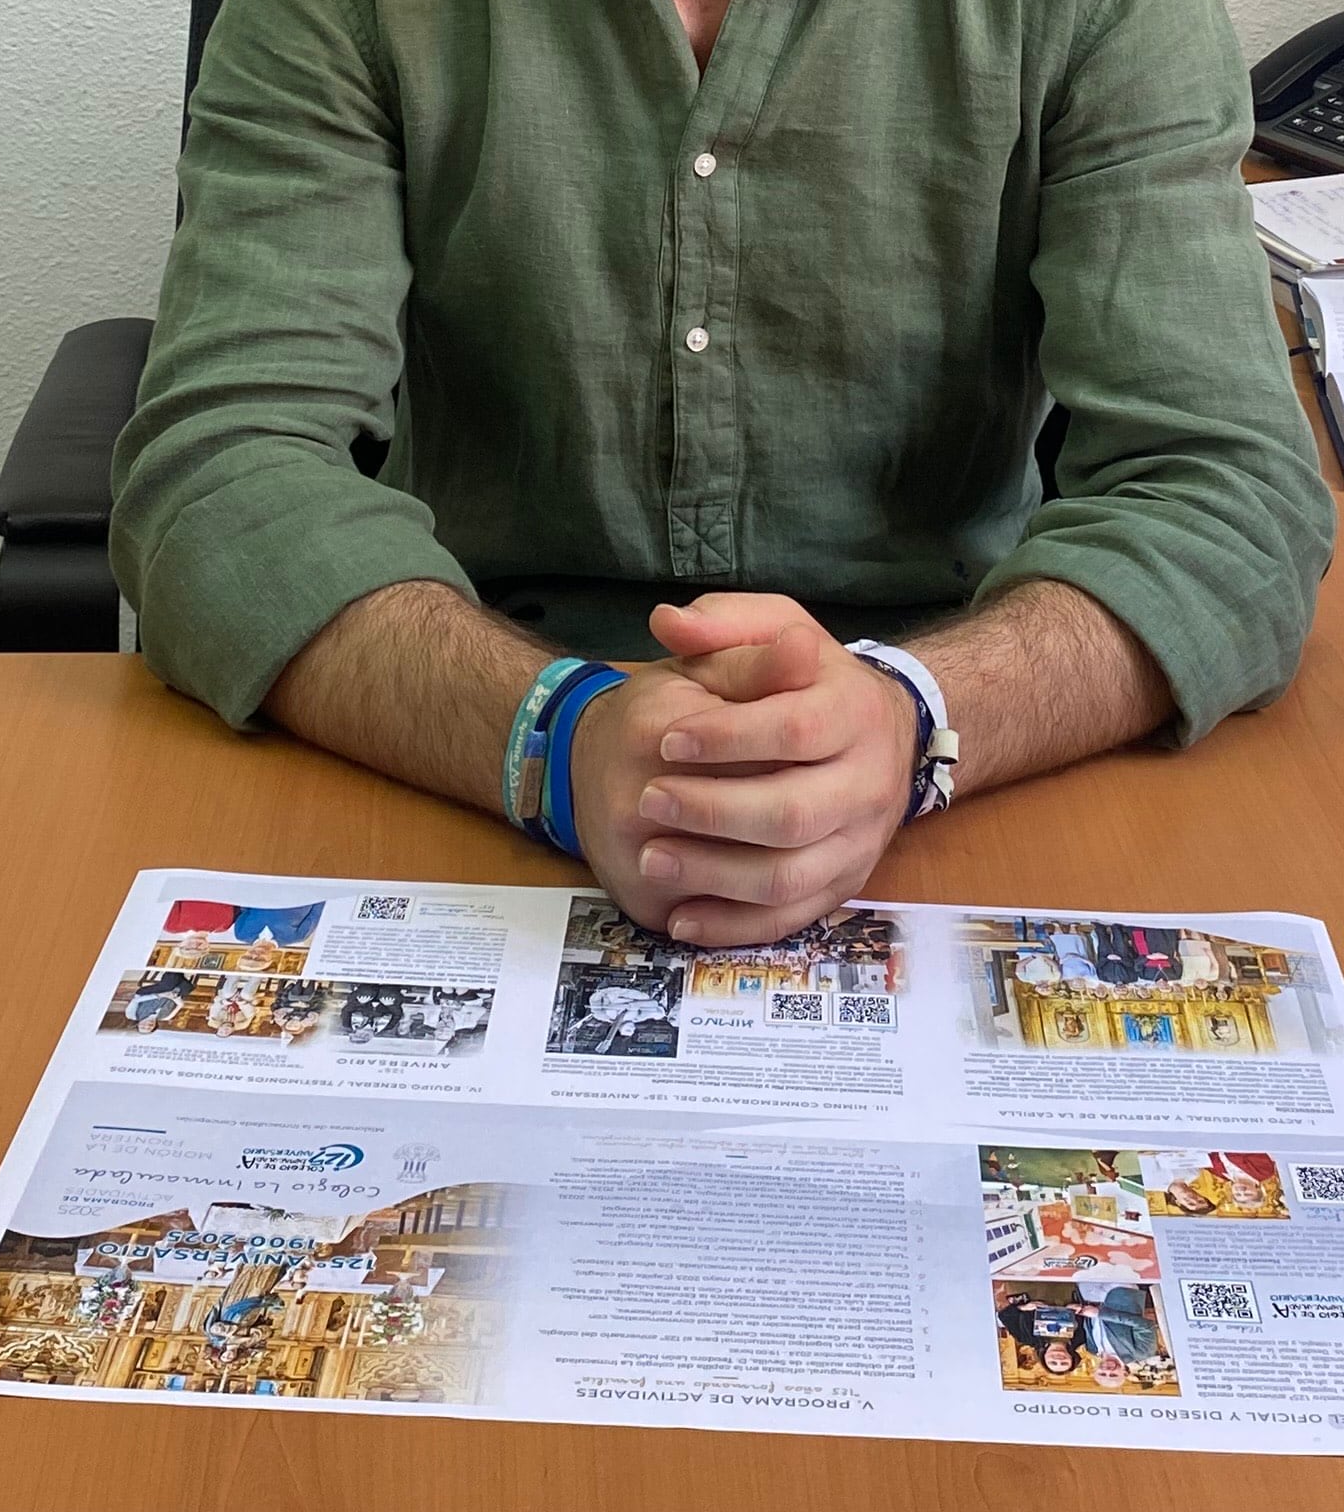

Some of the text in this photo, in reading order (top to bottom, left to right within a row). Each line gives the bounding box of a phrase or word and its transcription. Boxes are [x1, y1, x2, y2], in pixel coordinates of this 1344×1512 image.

[690, 1017, 754, 1029] HIMNO
[89, 1132, 184, 1147] FRONTERA
[86, 1143, 212, 1162] MORÓN DE LA
[73, 1167, 380, 1198] Colegio La Inmaculada
[62, 1195, 154, 1208] PROGRAMA DE
[58, 1205, 102, 1217] 2025
[166, 1230, 316, 1251] 1900-2025
[95, 1241, 305, 1269] ANIVERSARIO
[576, 1388, 701, 1402] ACTIVIDADES
[709, 1393, 733, 1404] DE
[741, 1395, 850, 1409] PROGRAMA
[1015, 1404, 1110, 1417] LOGOTIPO
[1119, 1407, 1142, 1417] DE
[1150, 1408, 1222, 1422] DISEÑO
[1230, 1412, 1241, 1421] Y
[1246, 1412, 1322, 1423] OFICIAL
